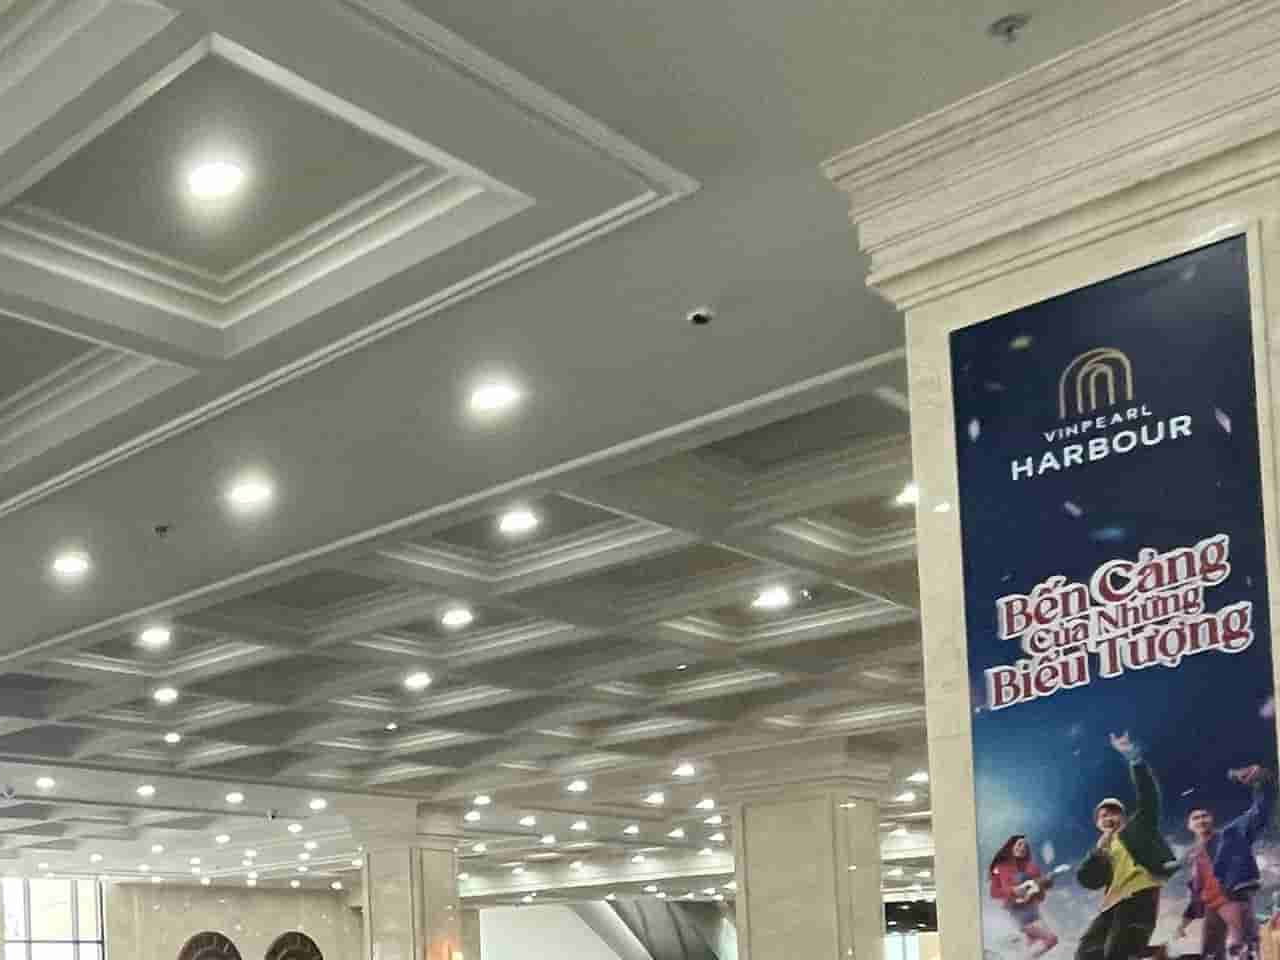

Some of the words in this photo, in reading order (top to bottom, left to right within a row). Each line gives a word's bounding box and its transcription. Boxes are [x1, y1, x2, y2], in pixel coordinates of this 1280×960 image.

[1010, 414, 1194, 481] HARBOUR
[1043, 405, 1153, 442] VINPEARL
[999, 577, 1089, 638] Bến
[1093, 535, 1229, 604] Cảng
[987, 651, 1089, 709] Biểu
[1099, 602, 1253, 676] Tượng
